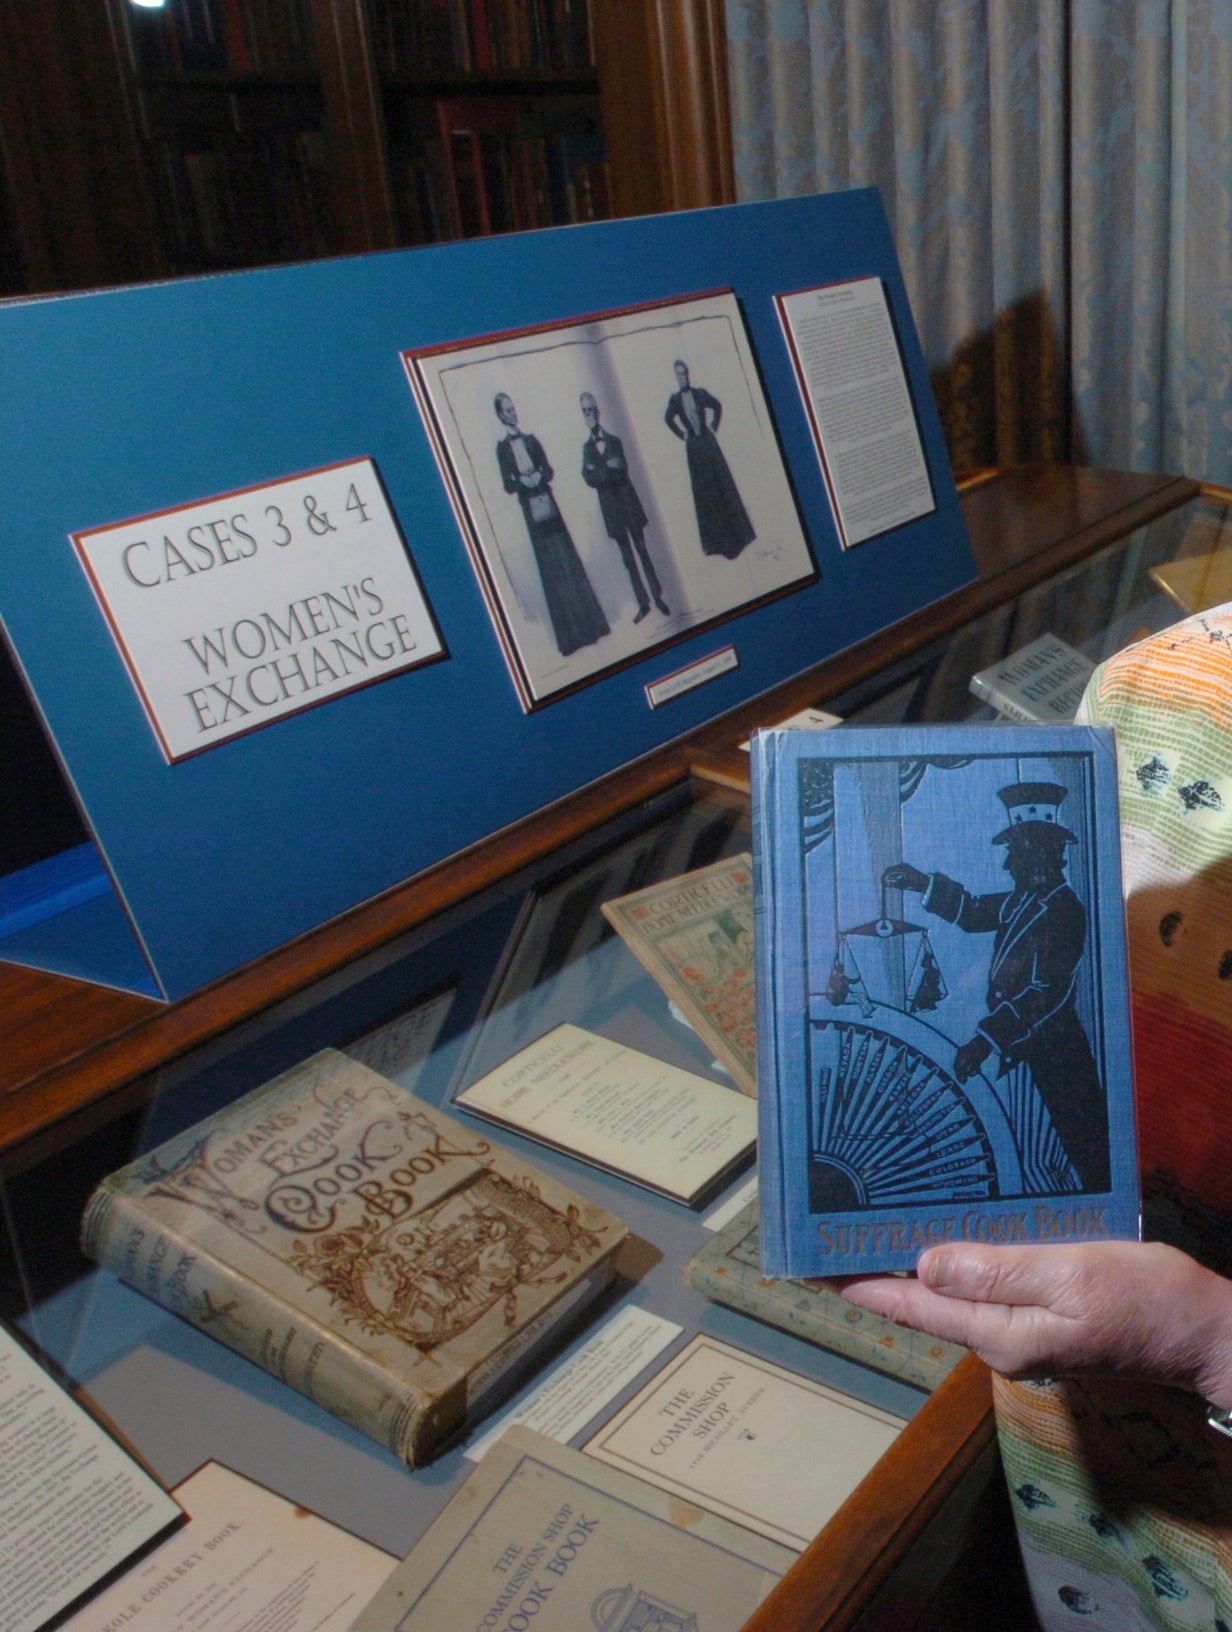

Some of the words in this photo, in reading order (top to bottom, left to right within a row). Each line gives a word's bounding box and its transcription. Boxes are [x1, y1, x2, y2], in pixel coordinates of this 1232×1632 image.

[122, 513, 258, 588] CASES
[265, 505, 292, 547] 3
[304, 494, 337, 537] &
[345, 481, 374, 524] 4
[183, 577, 386, 676] WOMEN'S
[183, 614, 418, 733] EXCHANGE
[259, 1087, 363, 1178] EXCHANGE
[264, 1120, 402, 1233] COOK
[352, 1136, 490, 1221] BOOK
[816, 1217, 959, 1257] SUFFRAGE
[963, 1209, 1029, 1244] COOK
[1035, 1205, 1112, 1240] BOOK
[650, 1371, 735, 1456] COMMISSION
[659, 1389, 695, 1416] THE
[693, 1402, 730, 1440] SHOP
[492, 1543, 523, 1575] THE
[542, 1504, 574, 1543] SHOP
[141, 1553, 203, 1603] COOKERY
[502, 1580, 556, 1632] OOK
[545, 1514, 600, 1577] BOOK
